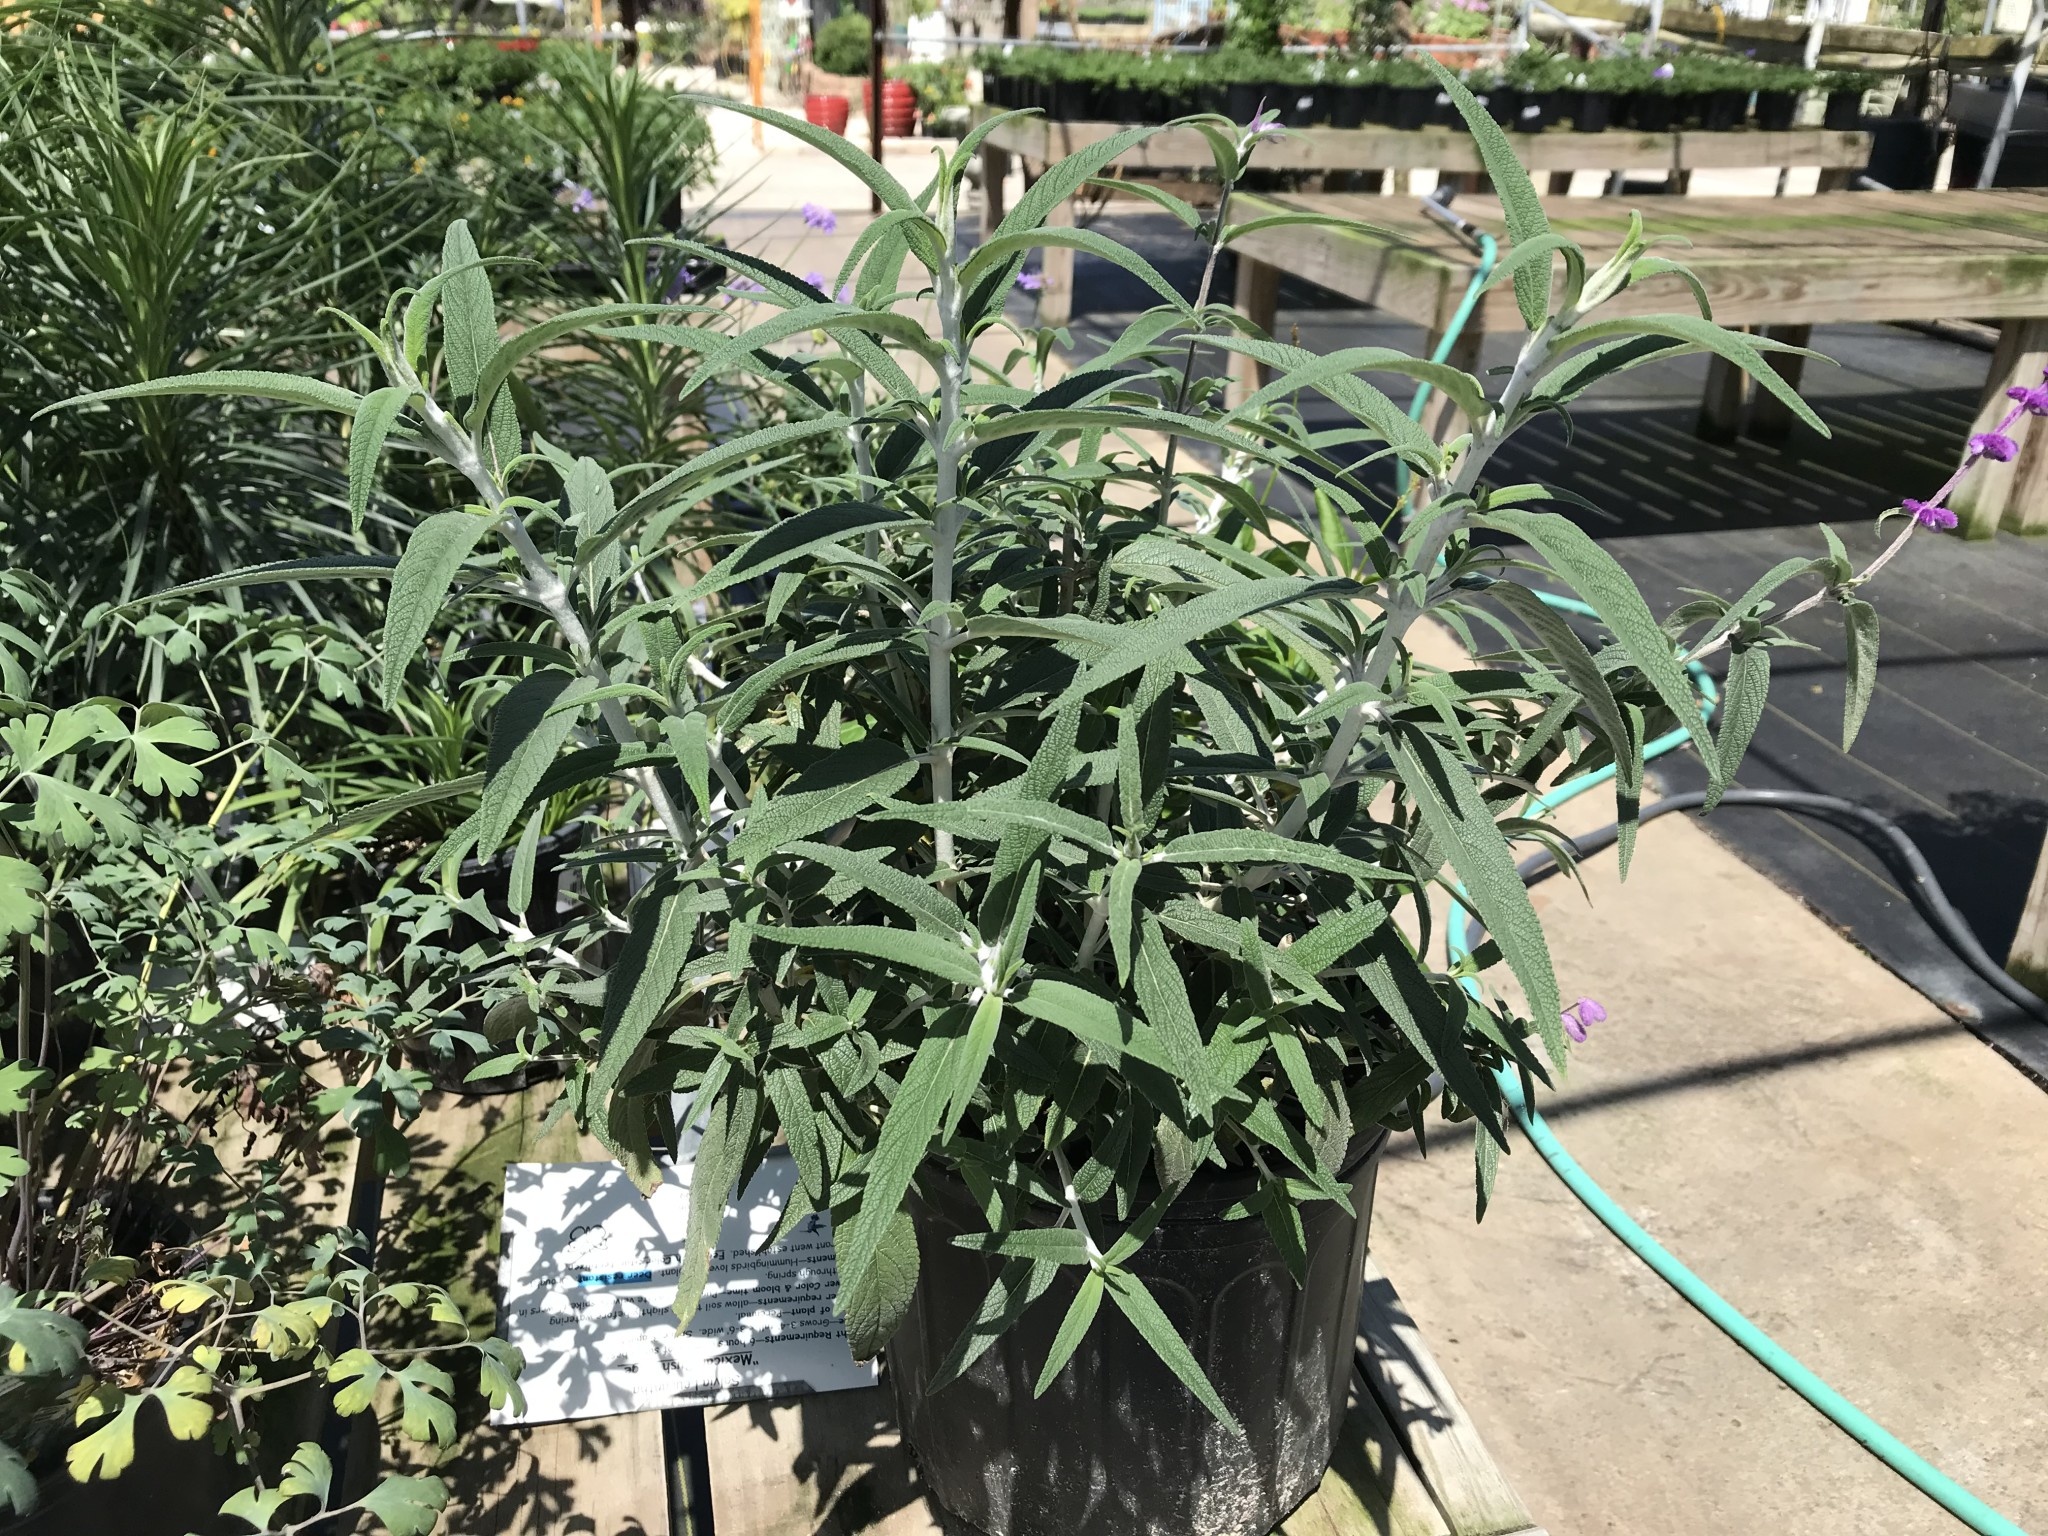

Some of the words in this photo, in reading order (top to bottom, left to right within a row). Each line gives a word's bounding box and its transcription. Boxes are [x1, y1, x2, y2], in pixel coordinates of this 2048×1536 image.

[791, 1243, 813, 1253] went
[709, 1264, 728, 1273] love
[731, 1255, 836, 1272] ments—Hummingbirds
[765, 1270, 797, 1281] spring.
[752, 1285, 781, 1297] bloom
[784, 1284, 792, 1294] &
[796, 1281, 821, 1292] Color
[705, 1302, 722, 1312] soil
[725, 1294, 822, 1310] requirements—allow
[518, 1308, 528, 1318] in
[820, 1306, 830, 1315] of
[699, 1327, 724, 1337] wide.
